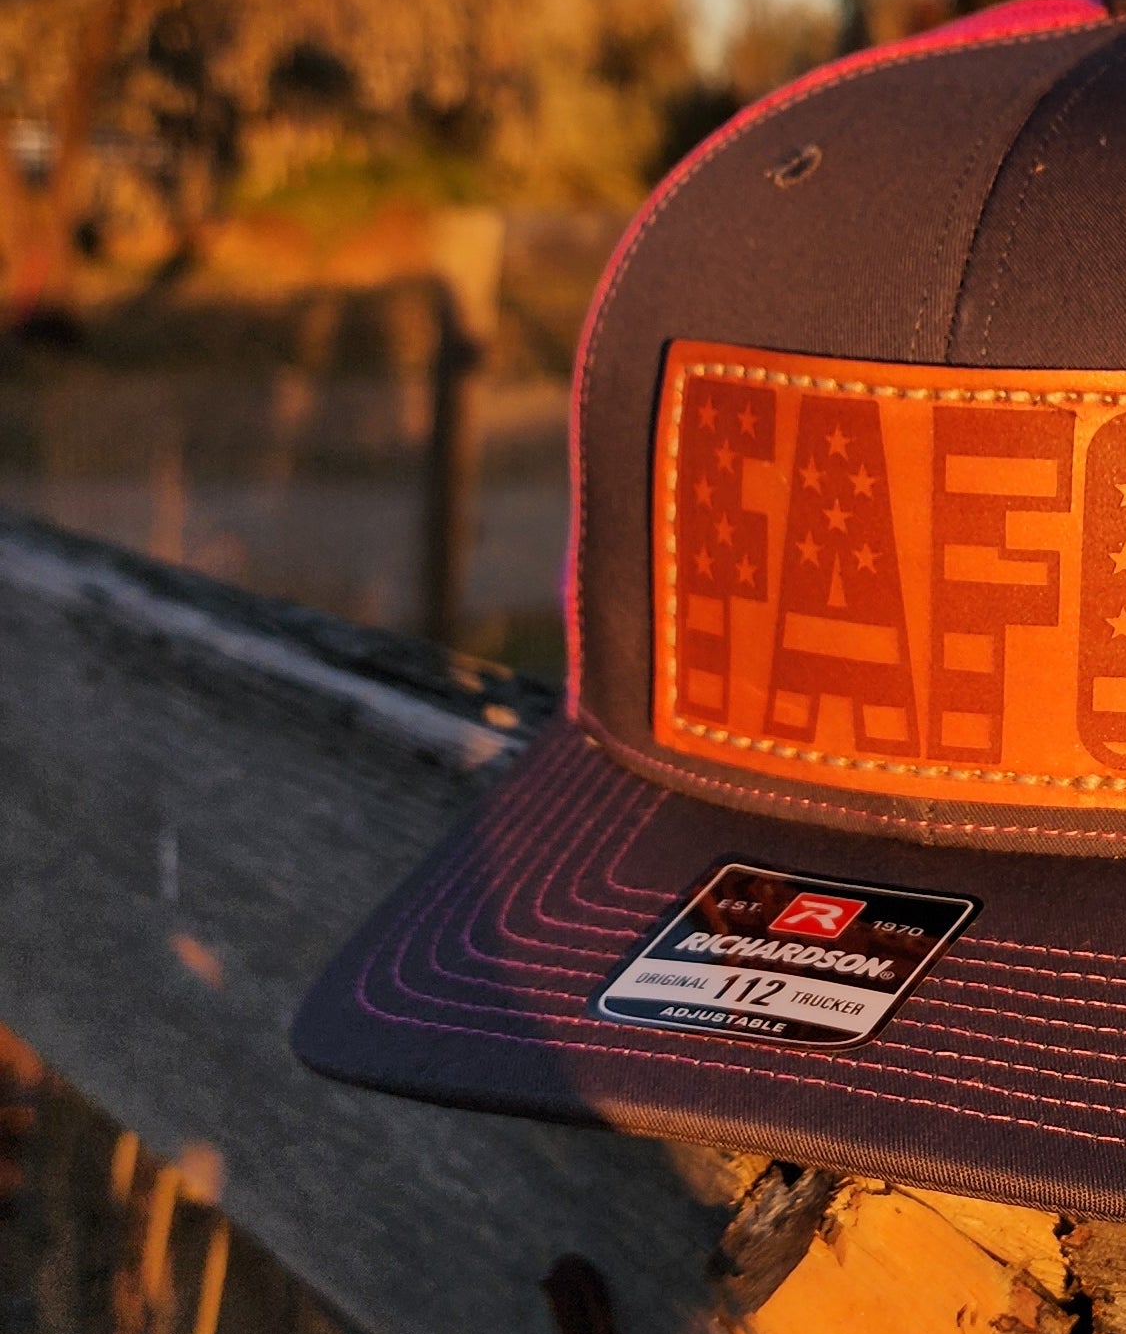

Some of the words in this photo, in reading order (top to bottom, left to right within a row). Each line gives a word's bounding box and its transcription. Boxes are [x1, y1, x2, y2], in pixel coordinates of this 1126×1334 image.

[717, 898, 762, 912] EST.
[785, 900, 843, 930] R
[873, 920, 924, 937] 1970
[635, 972, 709, 990] ORIGINAL
[713, 974, 787, 1006] 112
[790, 990, 866, 1016] TRUCKER
[659, 1006, 788, 1033] ADJUSTABLE
